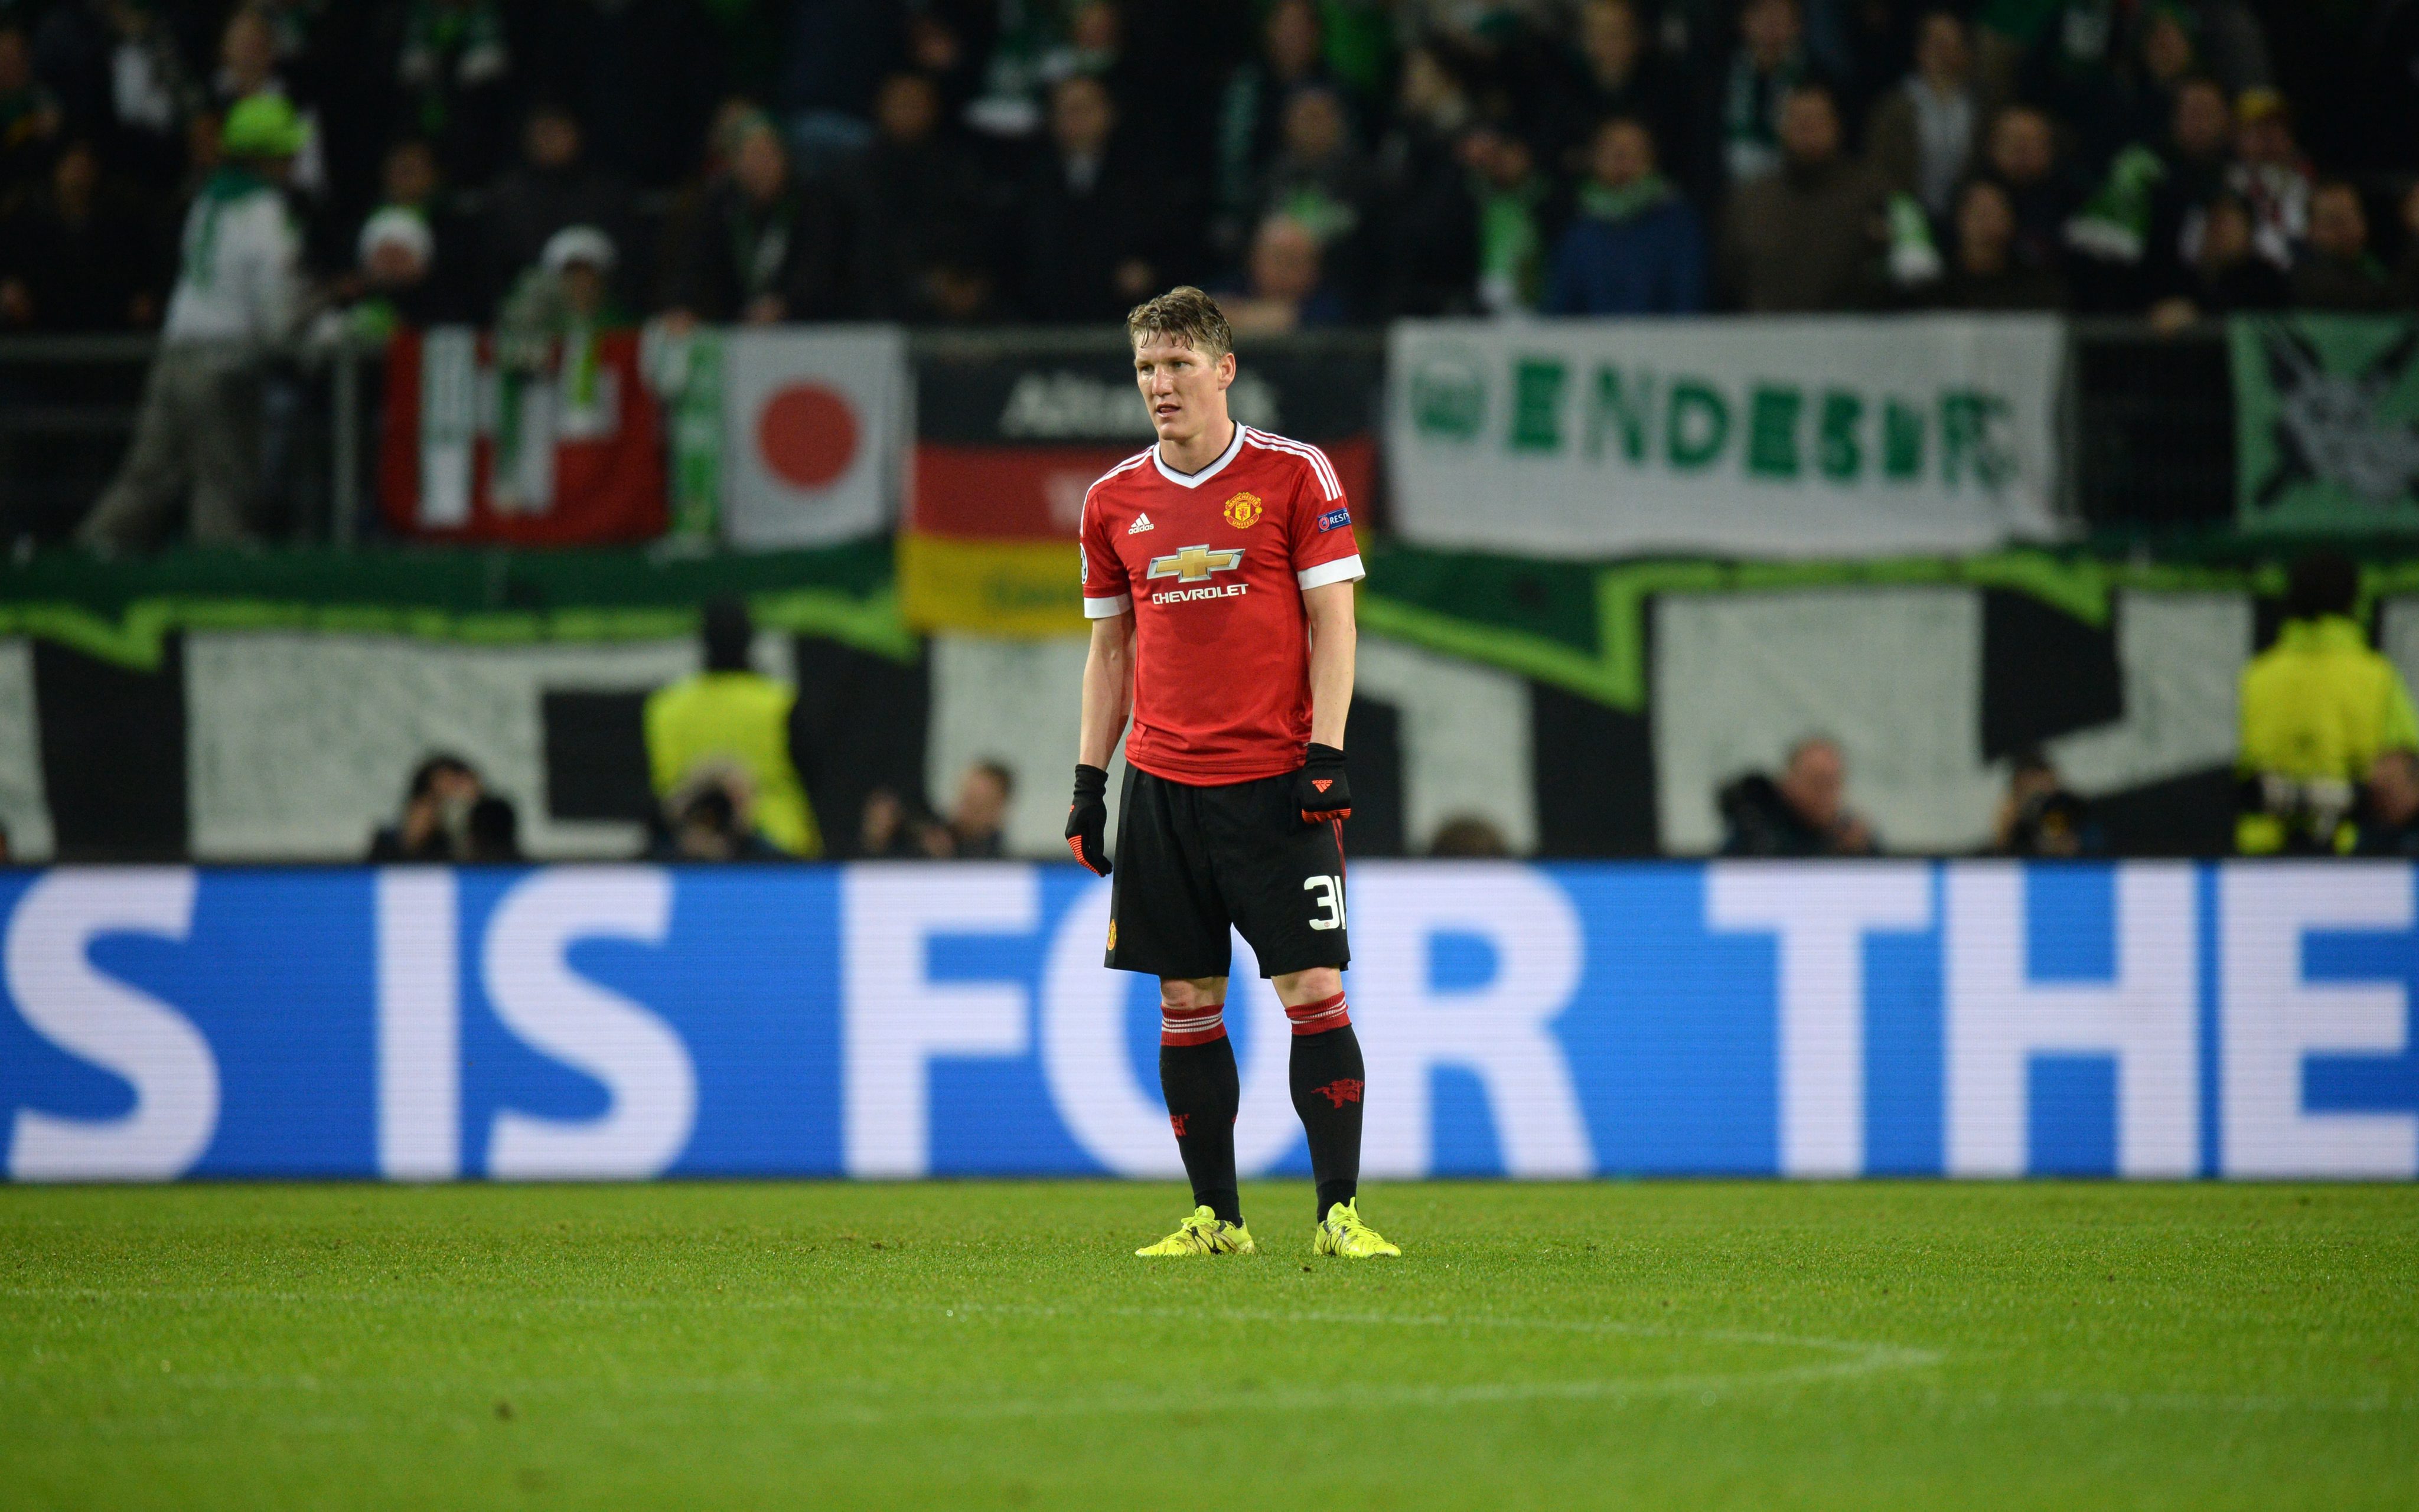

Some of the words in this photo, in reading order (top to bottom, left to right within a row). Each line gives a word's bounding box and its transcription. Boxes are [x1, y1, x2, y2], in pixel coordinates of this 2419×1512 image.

[1128, 524, 1155, 535] adidas
[1152, 583, 1249, 605] CHEVROLET
[1303, 875, 1346, 930] 31
[5, 863, 220, 1180] S
[375, 863, 697, 1180] IS
[840, 863, 1597, 1180] FOR
[1704, 861, 2419, 1178] THE
